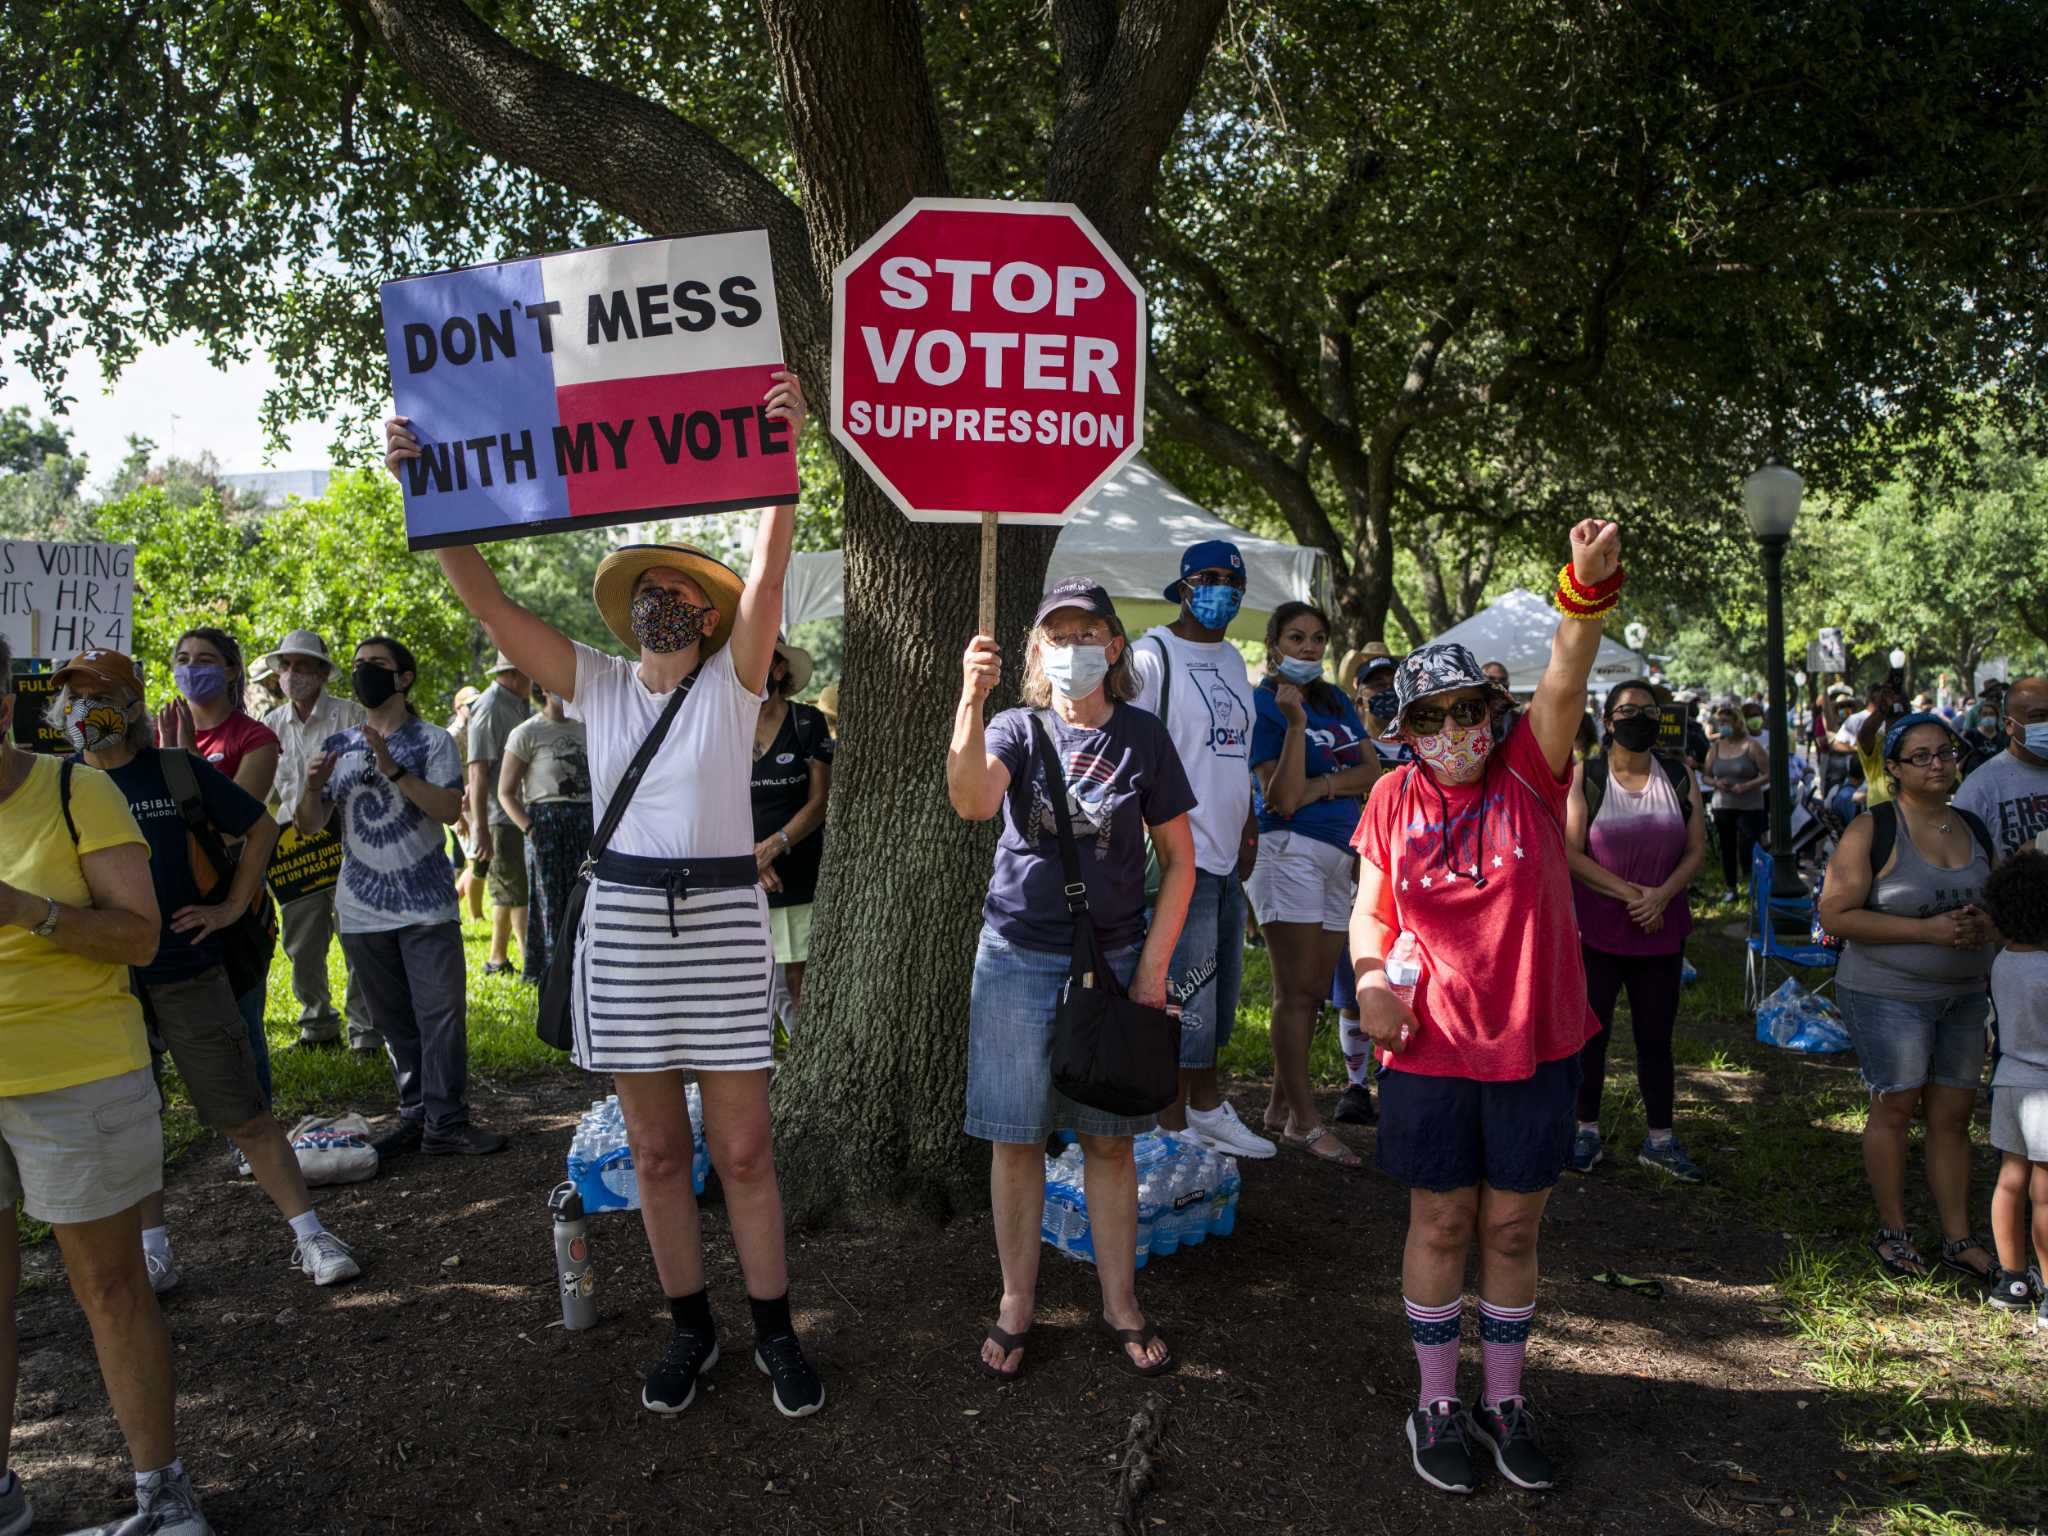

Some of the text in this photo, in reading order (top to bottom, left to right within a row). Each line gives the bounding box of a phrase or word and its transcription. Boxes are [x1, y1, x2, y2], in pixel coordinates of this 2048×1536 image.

[879, 256, 1106, 317] STOP
[404, 275, 763, 374] DON'T MESS
[860, 326, 1121, 395] VOTER
[407, 405, 790, 497] WITH MY VOTE
[848, 400, 1124, 449] SUPPRESSION
[3, 543, 130, 580] S VOTING
[0, 581, 34, 616] HTS
[38, 727, 64, 740] RIG
